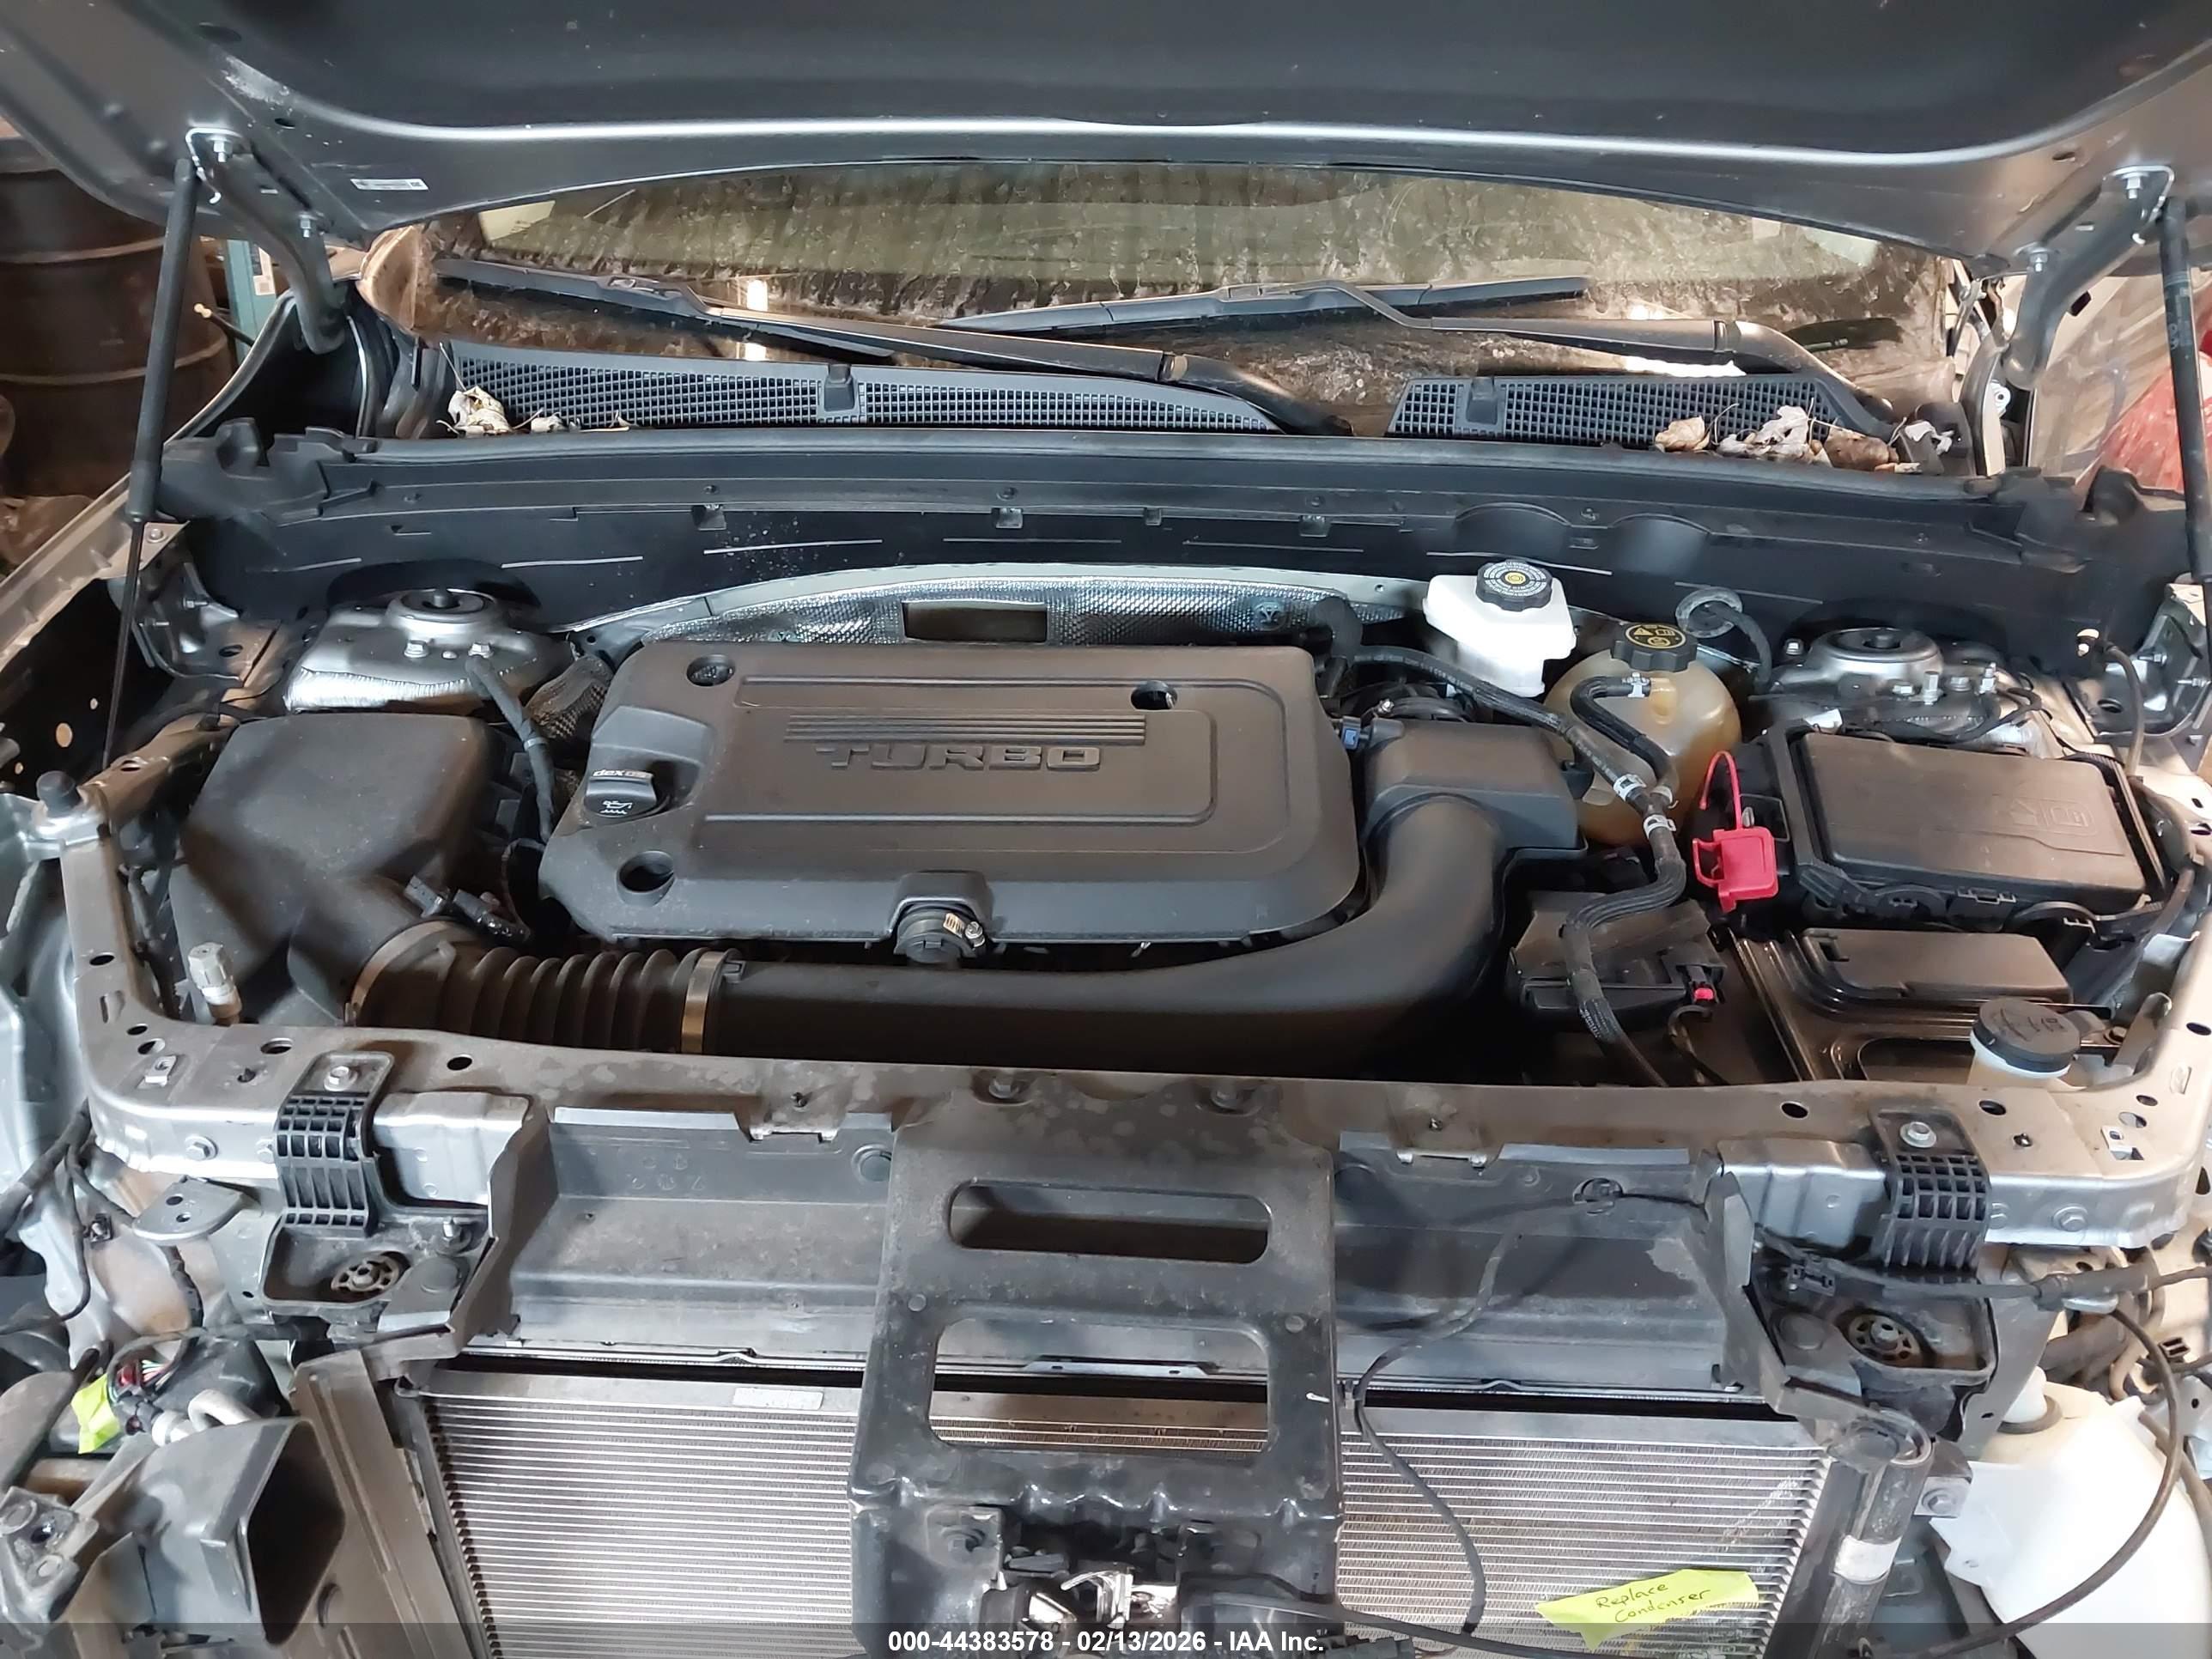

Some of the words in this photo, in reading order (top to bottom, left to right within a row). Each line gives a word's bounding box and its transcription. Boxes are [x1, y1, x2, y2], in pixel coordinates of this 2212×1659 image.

[816, 744, 1100, 771] TURBO
[1595, 1583, 1668, 1609] Replace
[1614, 1589, 1711, 1623] Condenser
